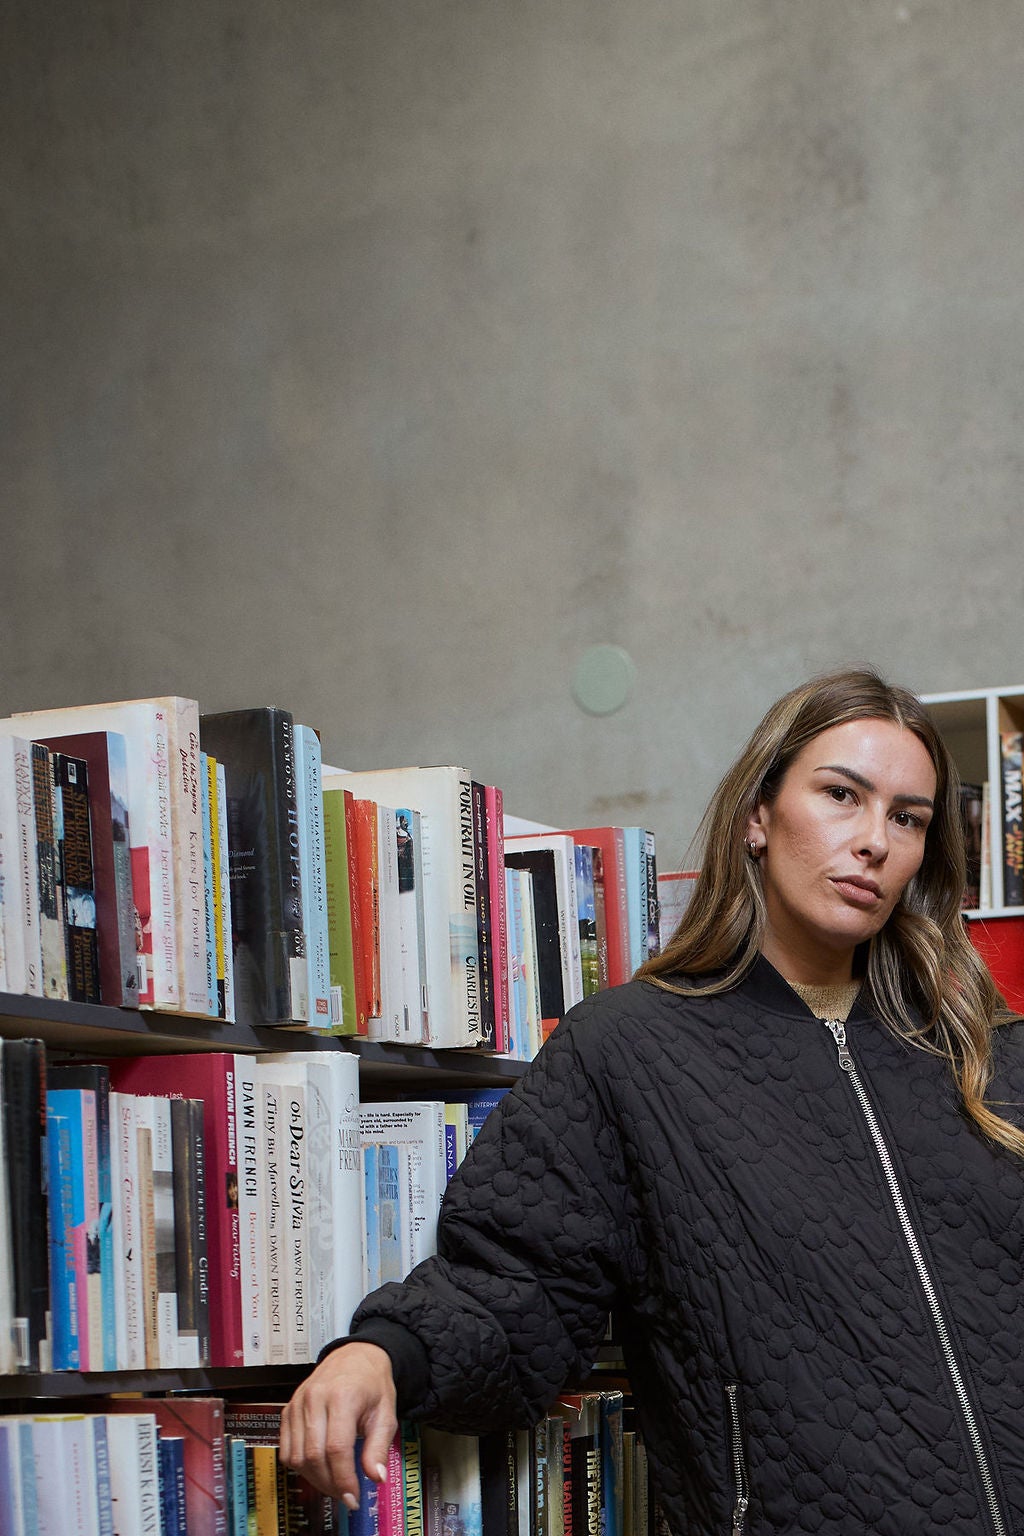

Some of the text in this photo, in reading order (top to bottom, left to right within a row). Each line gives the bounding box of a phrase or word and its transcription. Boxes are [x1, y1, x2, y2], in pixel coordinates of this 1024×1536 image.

[179, 748, 190, 795] Detective
[281, 721, 295, 800] DIAMOND
[311, 754, 317, 763] A
[475, 792, 483, 843] CHRIS
[1005, 769, 1022, 822] MAX
[286, 808, 302, 889] HOPE
[314, 805, 322, 860] BEHAVED
[459, 780, 476, 911] PORTRAIT IN OIL
[160, 850, 172, 908] beneath
[190, 831, 200, 958] KAREN JOY FOWLER
[316, 868, 324, 912] WOMAN
[481, 930, 486, 943] IN
[465, 955, 480, 1034] CHARLES FOX
[226, 1071, 236, 1166] DAWN FRENCH
[242, 1081, 257, 1197] DAWN FRENCH
[264, 1098, 280, 1230] Tiny Bit Marvellous
[289, 1124, 305, 1230] Dear Silvia
[446, 1134, 457, 1169] TANA
[195, 1135, 206, 1241] ALBERT FRENCH
[249, 1212, 257, 1269] Because
[198, 1256, 208, 1305] Cinder
[251, 1273, 259, 1287] of
[270, 1235, 281, 1333] DAWN FRENCH
[294, 1239, 304, 1332] DAWN FRENCH
[138, 1422, 156, 1532] ERNEST GANN
[212, 1437, 222, 1478] NIGHT
[235, 1449, 245, 1508] DISTANT
[586, 1449, 597, 1481] THE
[176, 1467, 186, 1531] SERAPHIM
[214, 1507, 225, 1535] THE
